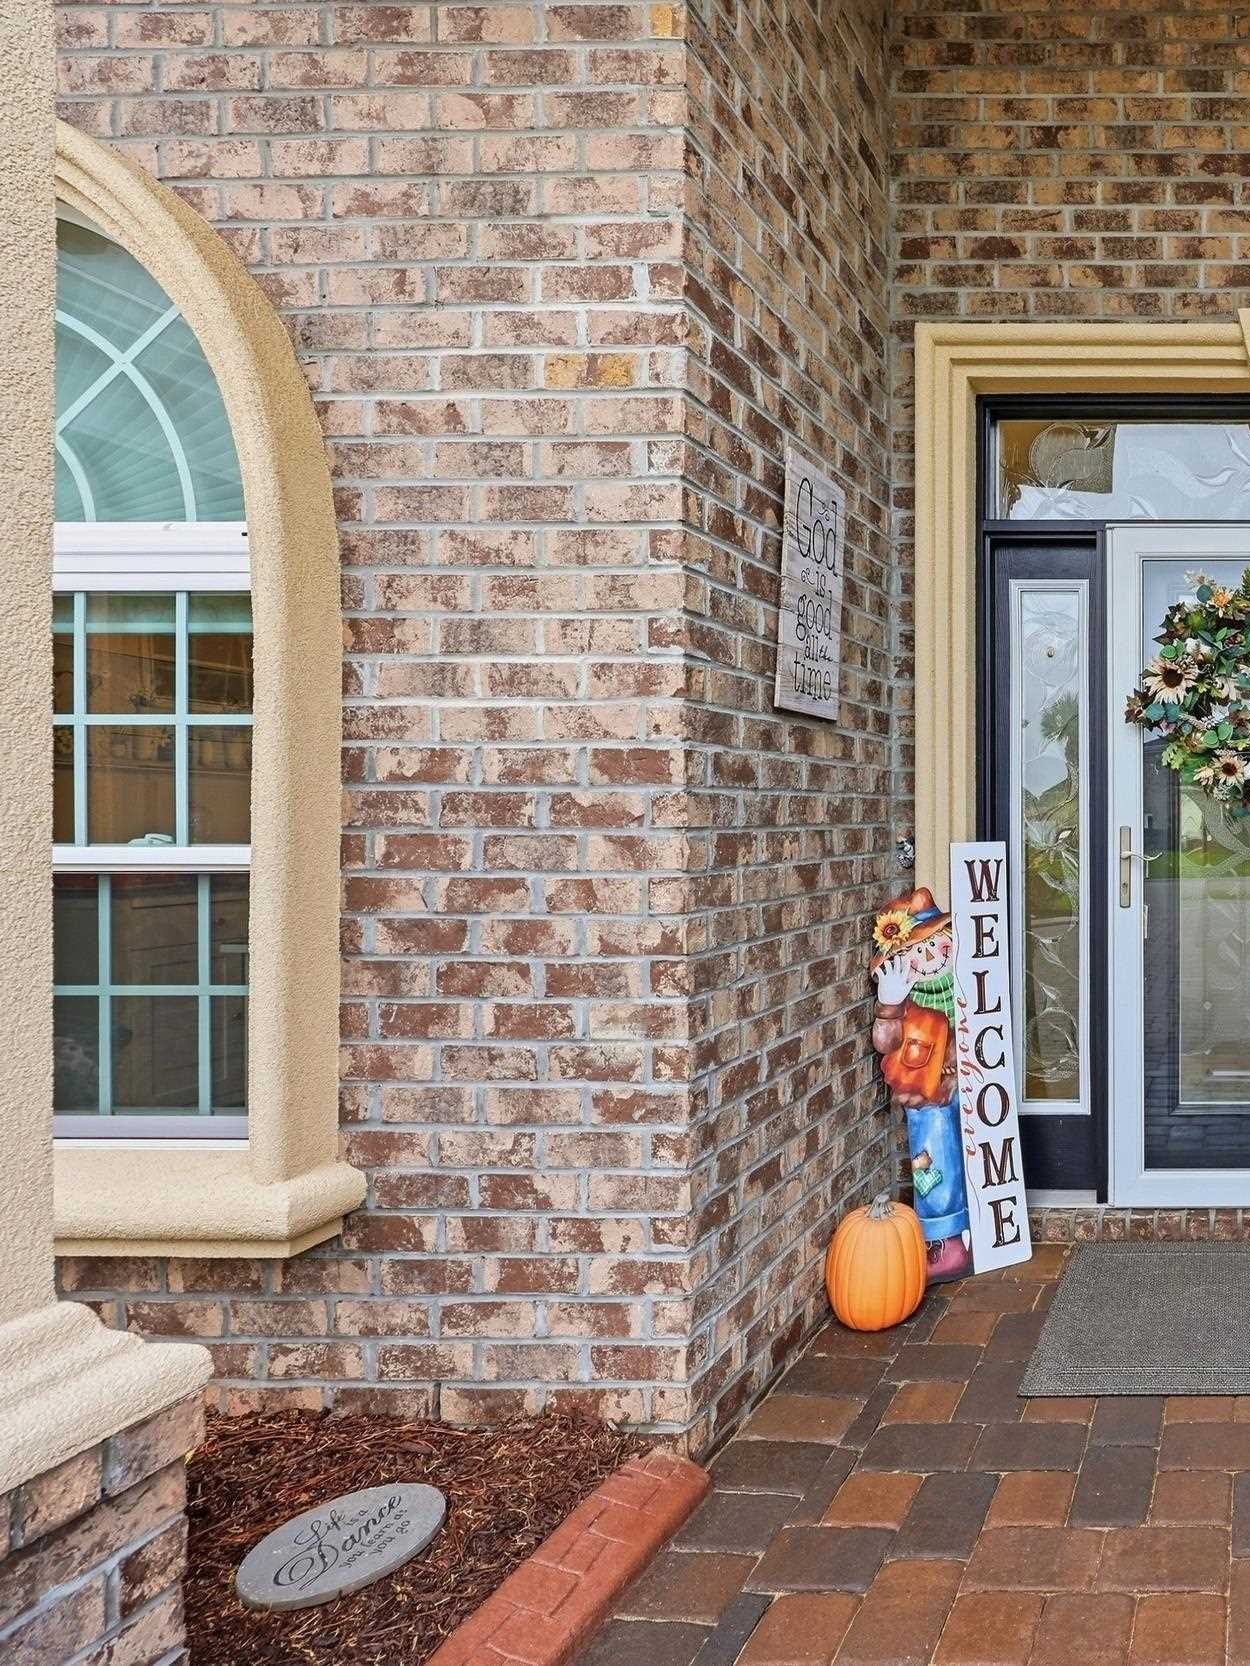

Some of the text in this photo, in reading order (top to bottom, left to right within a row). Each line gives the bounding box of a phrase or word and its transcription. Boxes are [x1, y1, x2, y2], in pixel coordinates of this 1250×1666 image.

[796, 477, 838, 578] God
[795, 589, 832, 641] good
[804, 634, 819, 662] all
[794, 650, 832, 701] time
[956, 995, 985, 1158] everyone
[964, 858, 1021, 1249] WELCOME
[273, 1495, 402, 1591] Dance
[294, 1509, 346, 1546] Life
